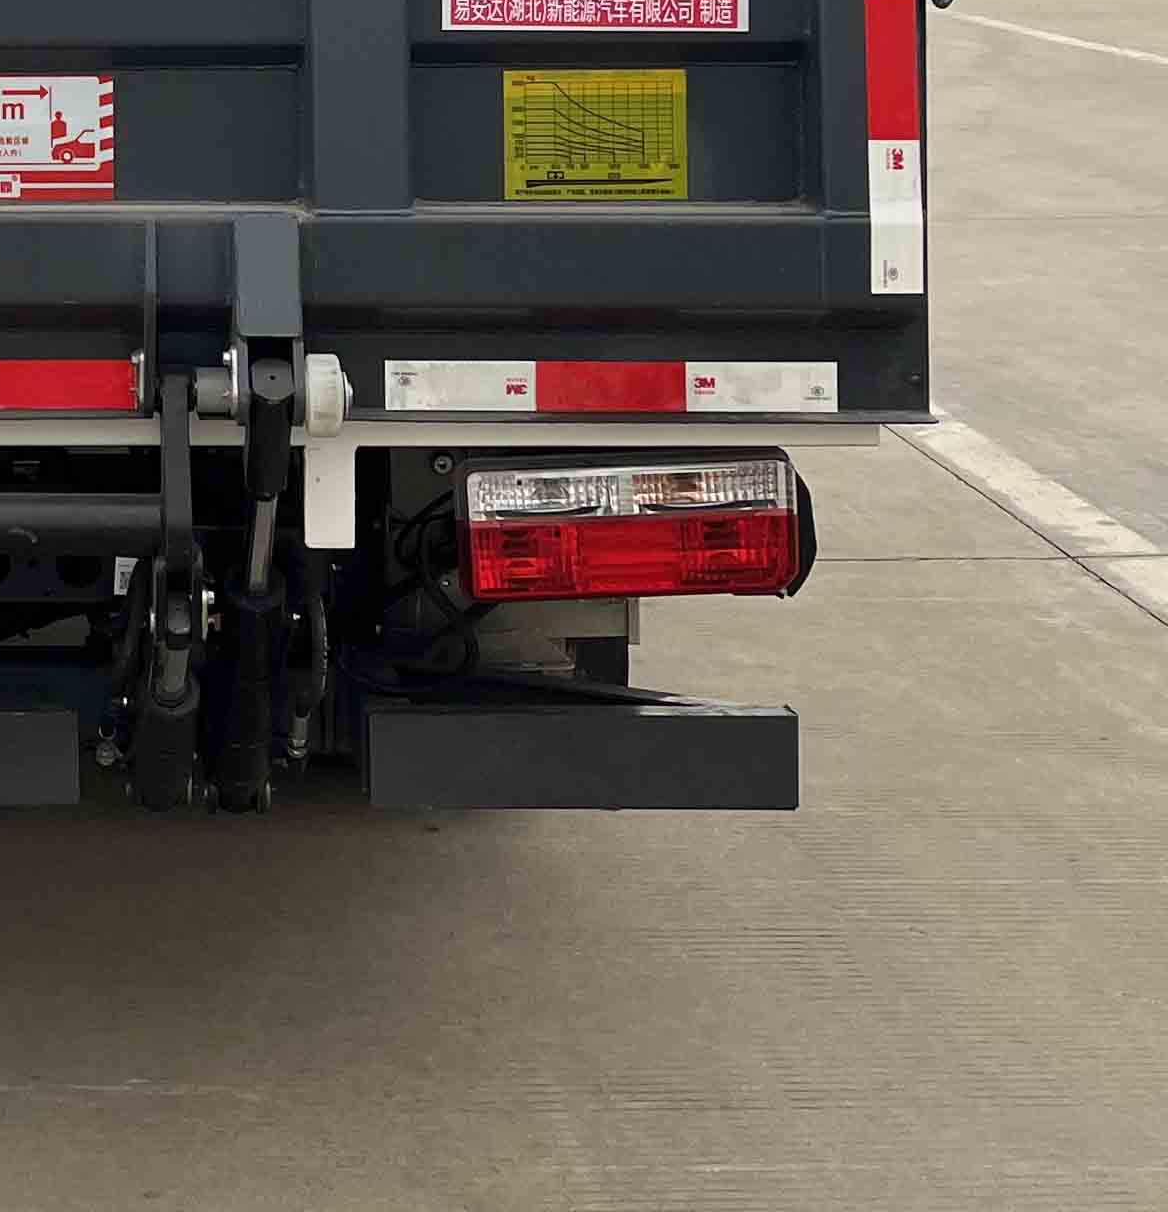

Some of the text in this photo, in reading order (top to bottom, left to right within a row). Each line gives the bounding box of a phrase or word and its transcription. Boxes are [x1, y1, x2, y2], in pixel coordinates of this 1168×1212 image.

[892, 148, 904, 169] 3M
[694, 377, 716, 388] 3M
[505, 384, 527, 395] 3M
